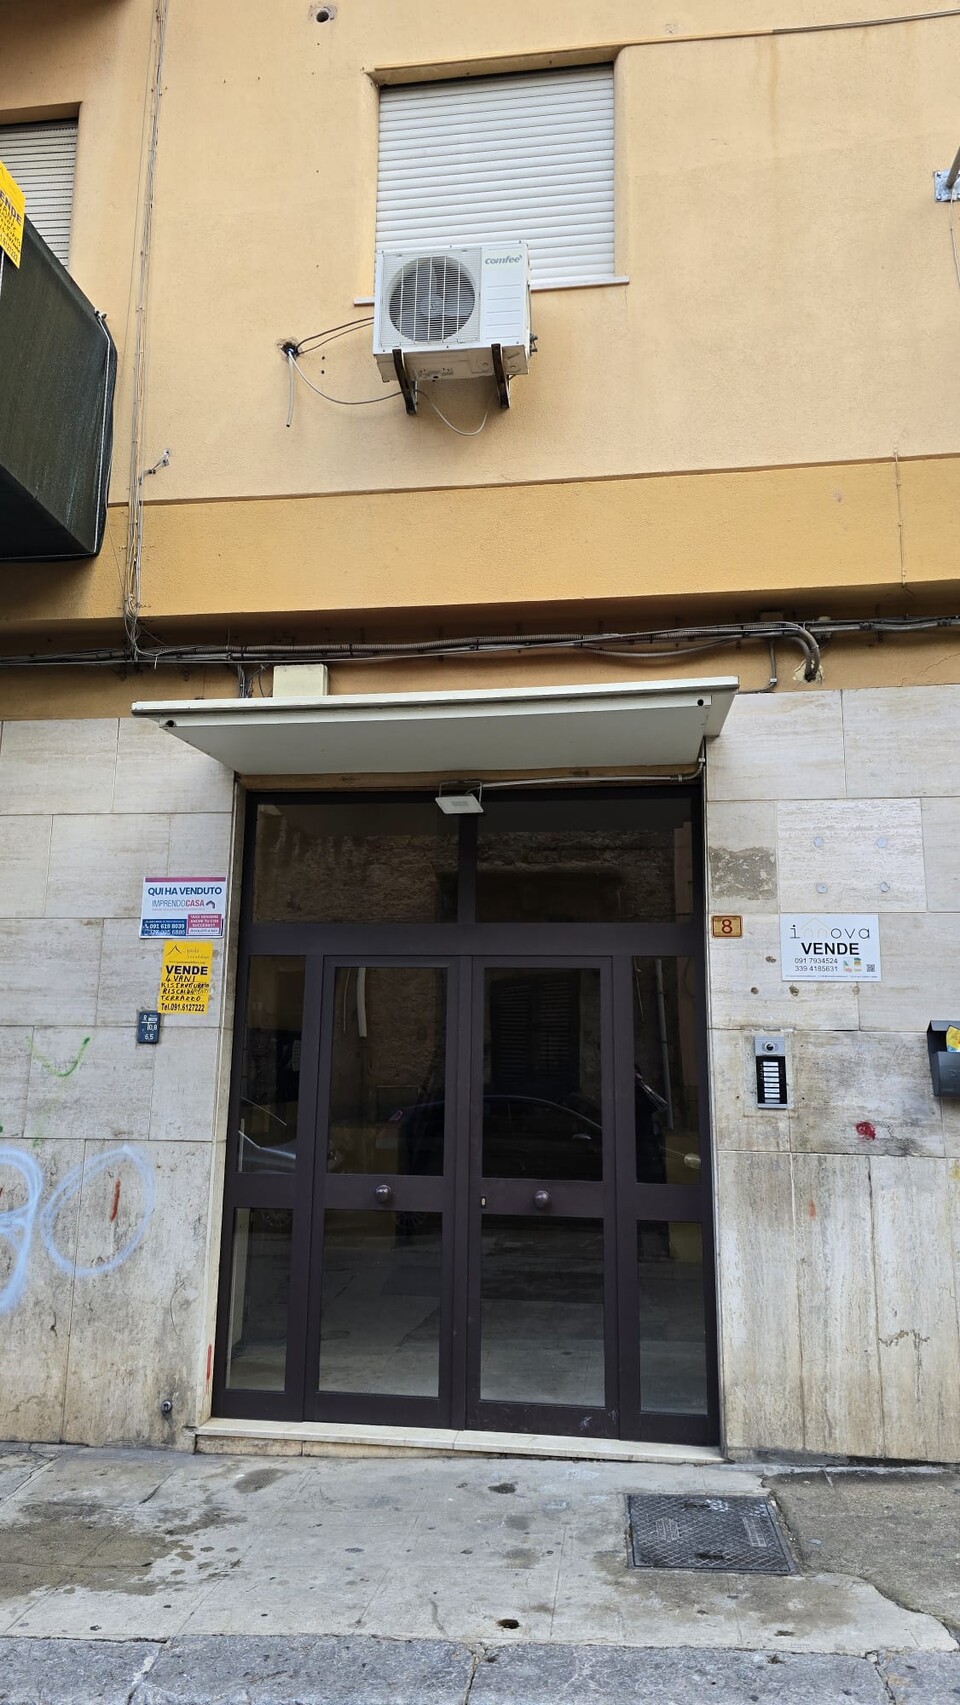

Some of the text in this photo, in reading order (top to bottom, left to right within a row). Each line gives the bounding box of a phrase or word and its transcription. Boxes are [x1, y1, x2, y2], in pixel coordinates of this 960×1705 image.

[0, 189, 22, 226] ENDE
[148, 887, 222, 896] QUI HA VENDUTO
[722, 919, 733, 934] 8
[801, 942, 860, 955] VENDE
[165, 965, 208, 975] VENDE
